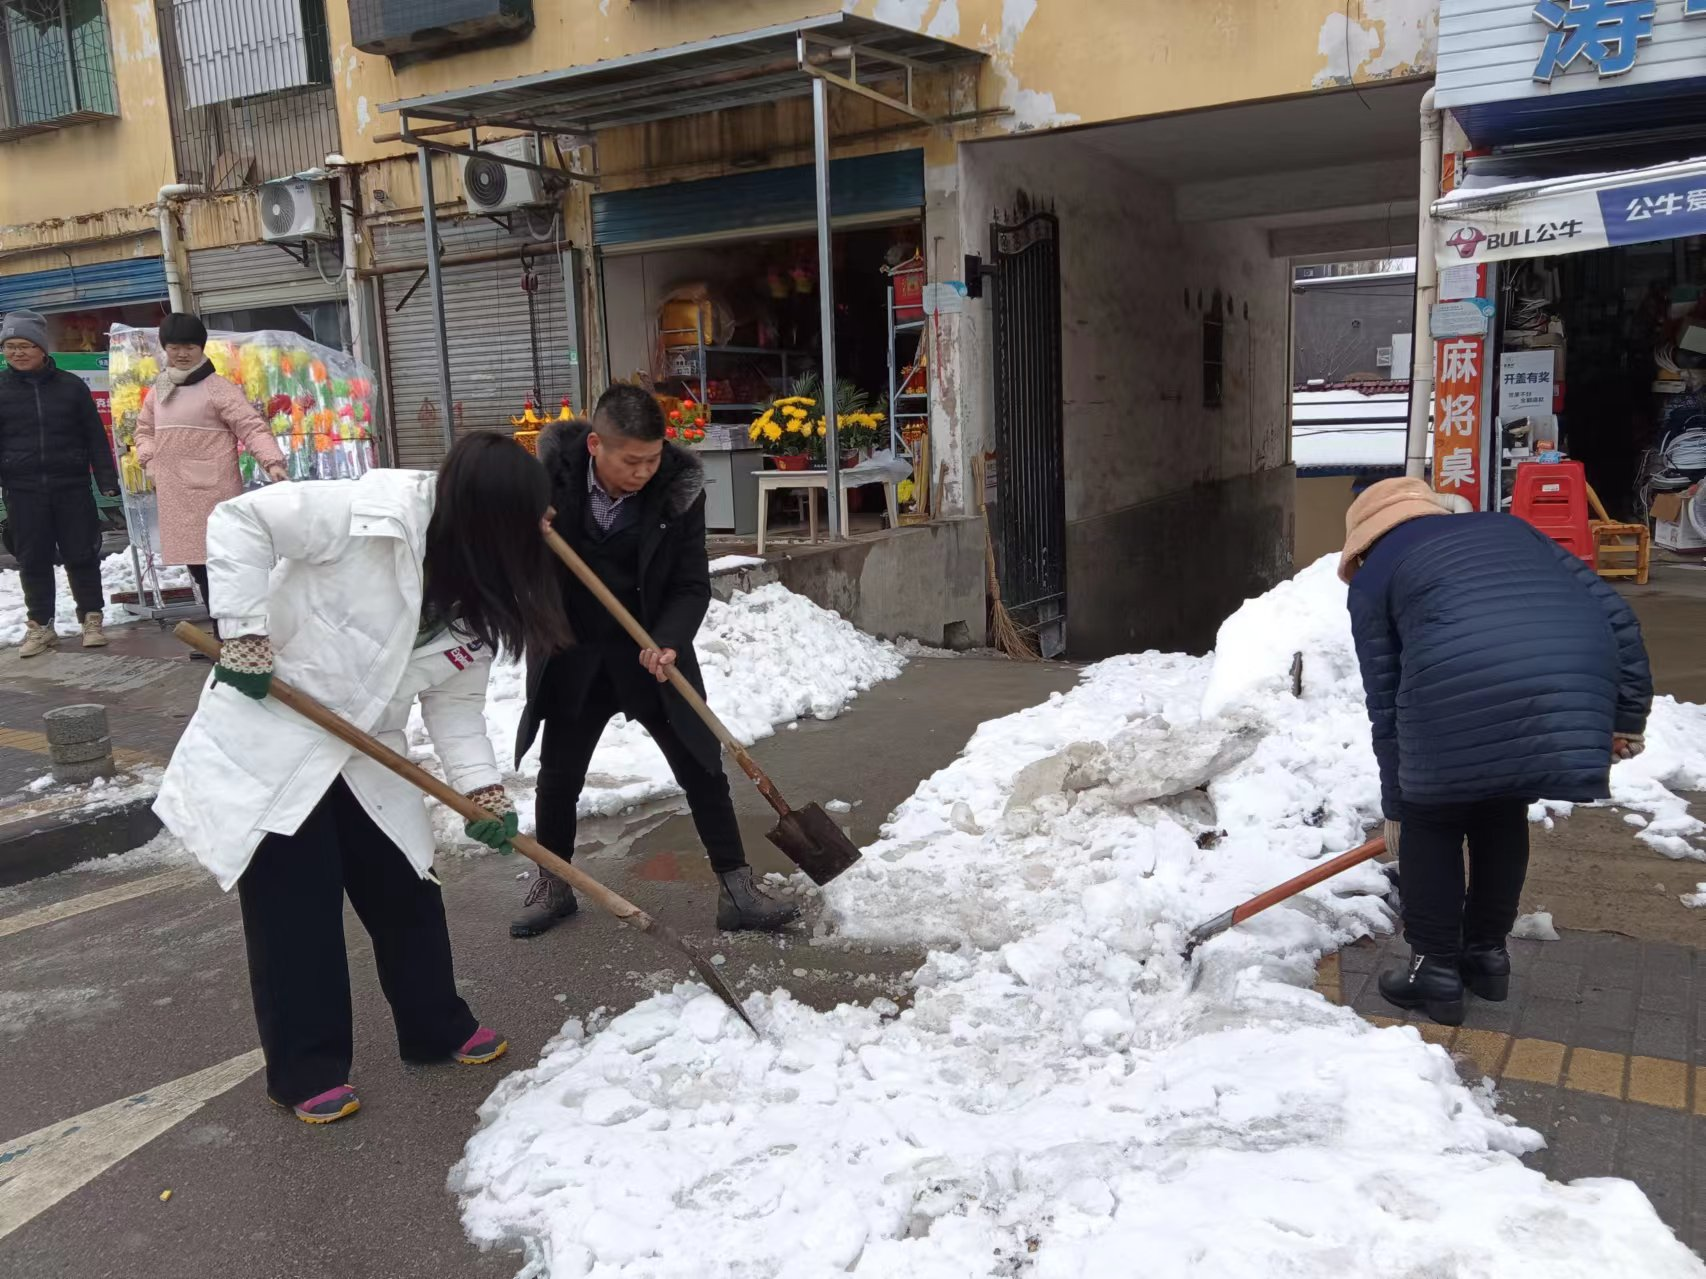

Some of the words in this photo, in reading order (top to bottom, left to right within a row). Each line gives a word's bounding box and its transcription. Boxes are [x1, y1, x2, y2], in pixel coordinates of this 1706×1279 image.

[1532, 0, 1706, 84] 涛
[1439, 338, 1478, 488] 麻将桌
[1504, 371, 1550, 385] 开盖有奖
